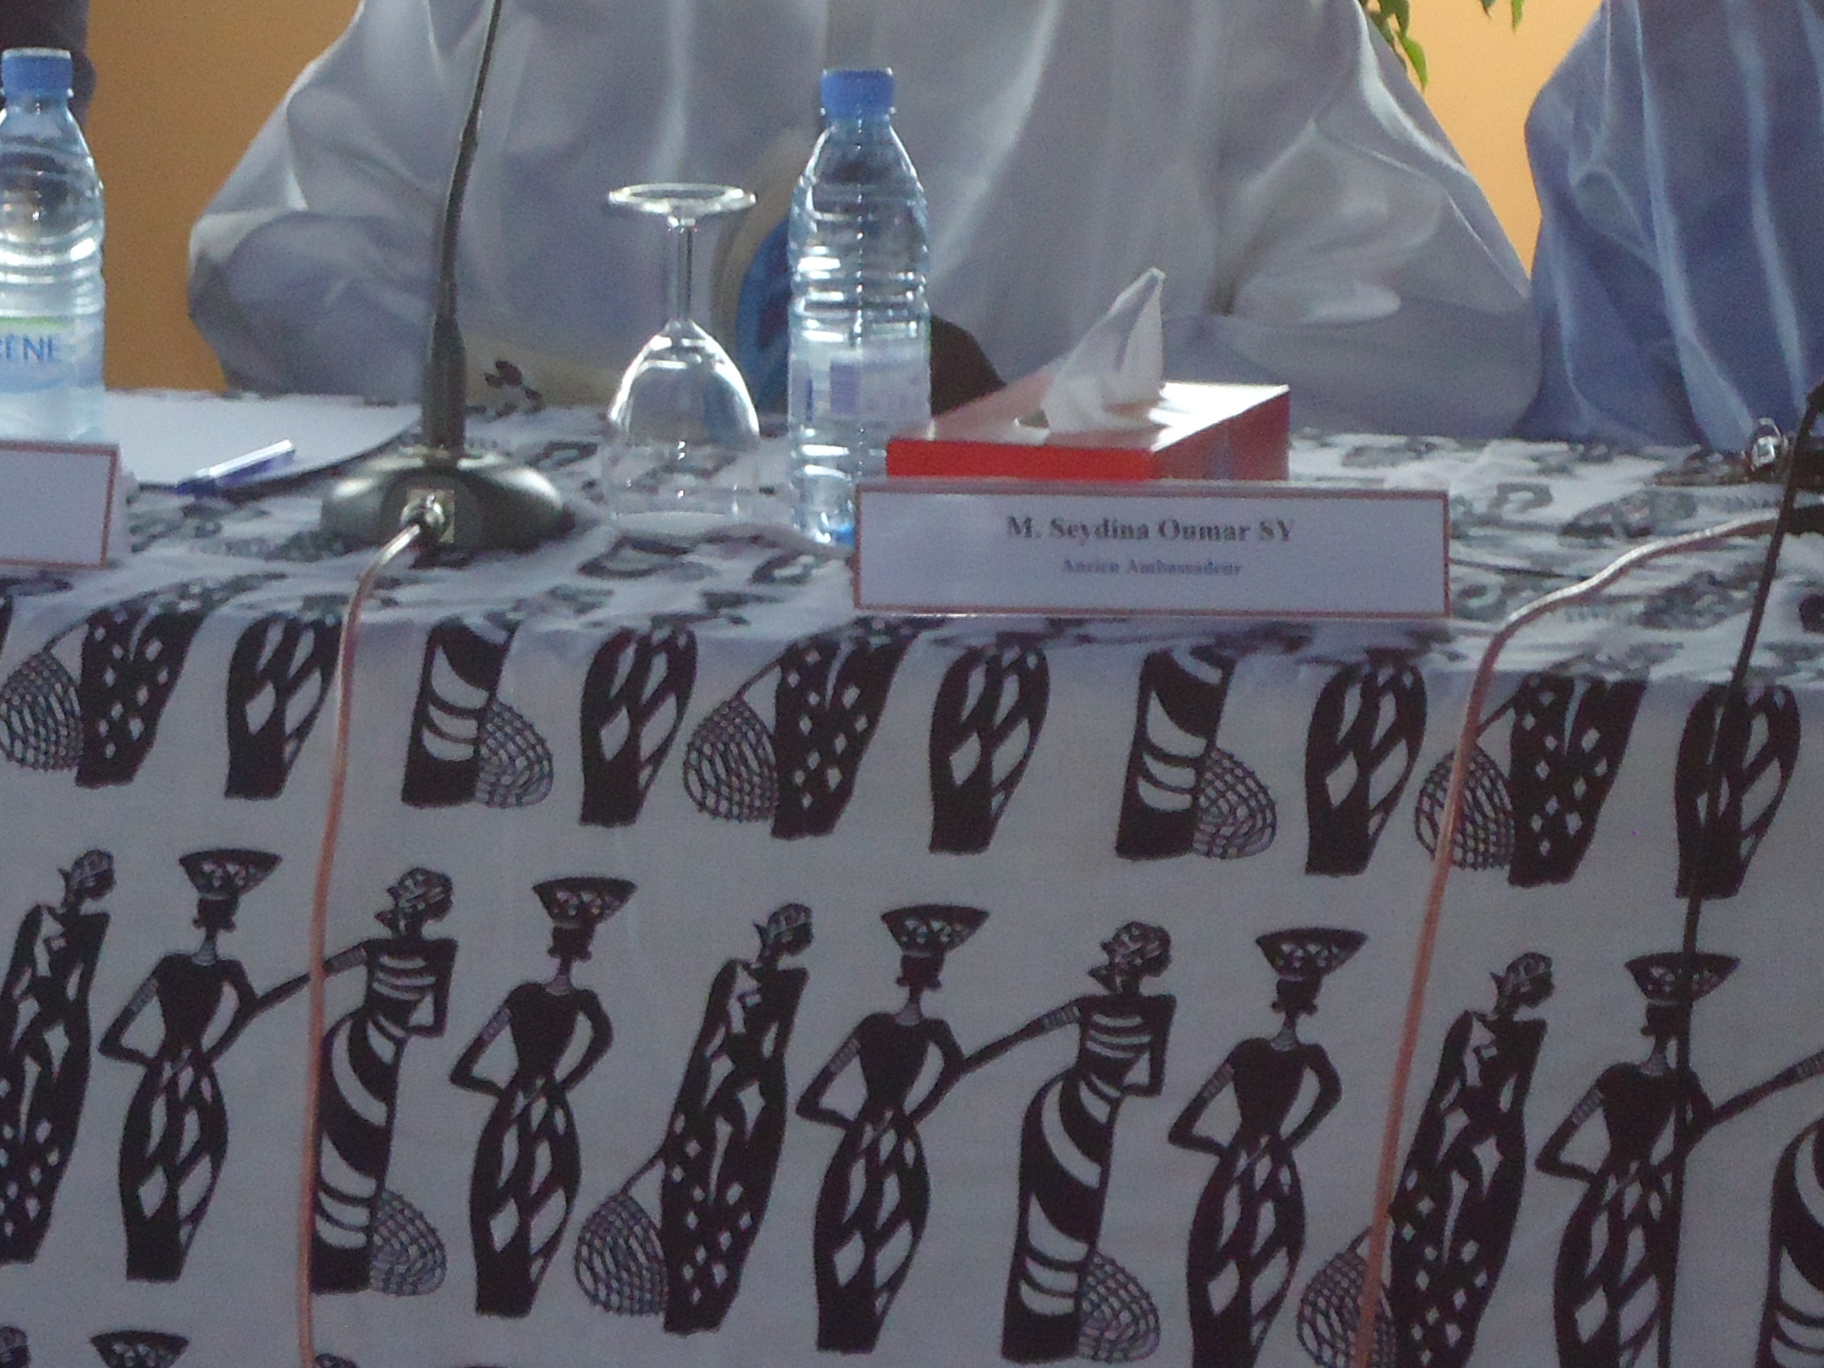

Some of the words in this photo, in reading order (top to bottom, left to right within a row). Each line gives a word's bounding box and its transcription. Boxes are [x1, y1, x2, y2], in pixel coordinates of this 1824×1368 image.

[1007, 515, 1042, 539] M.
[1049, 517, 1150, 546] Seydina
[1157, 518, 1251, 541] Oumar
[1259, 518, 1295, 542] SY
[1063, 558, 1120, 575] Ancien
[1128, 558, 1243, 576] Ambassadeur
